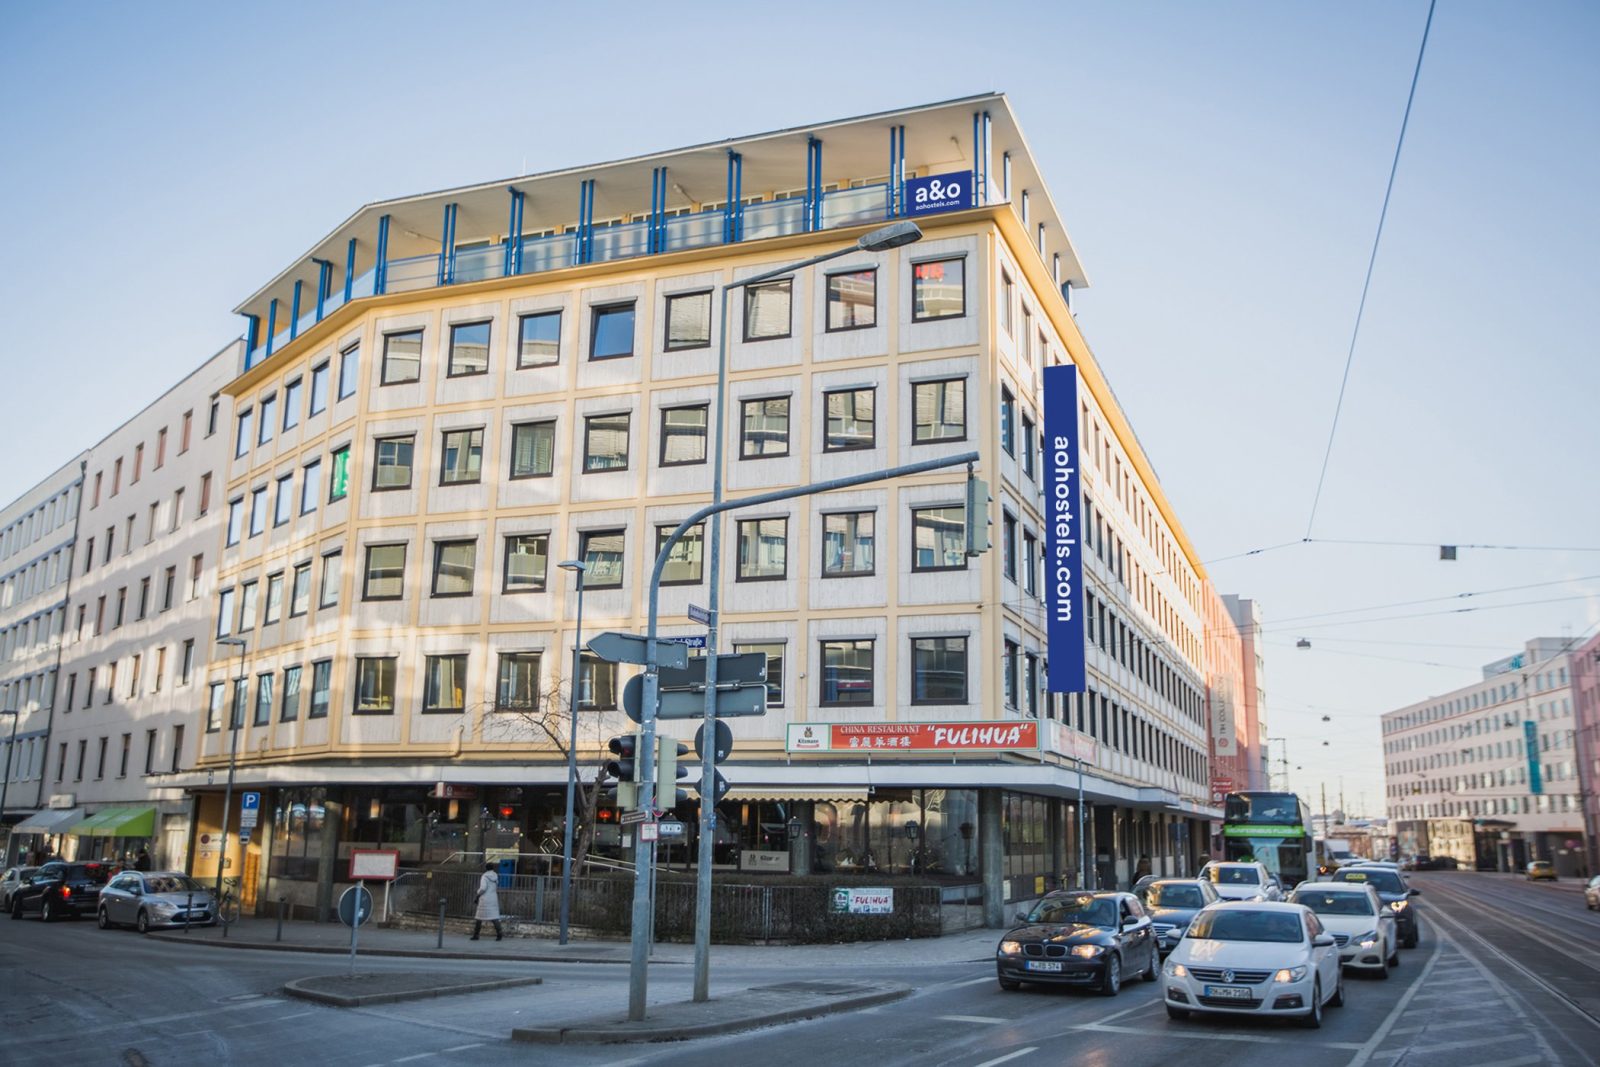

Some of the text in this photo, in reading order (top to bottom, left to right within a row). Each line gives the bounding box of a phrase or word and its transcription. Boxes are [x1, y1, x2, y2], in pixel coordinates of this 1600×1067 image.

[915, 179, 961, 203] a&o
[915, 200, 960, 211] aohostels.com
[1054, 436, 1075, 622] aohostels.com
[840, 724, 920, 734] CHINA RESTAURANT
[246, 794, 256, 807] P
